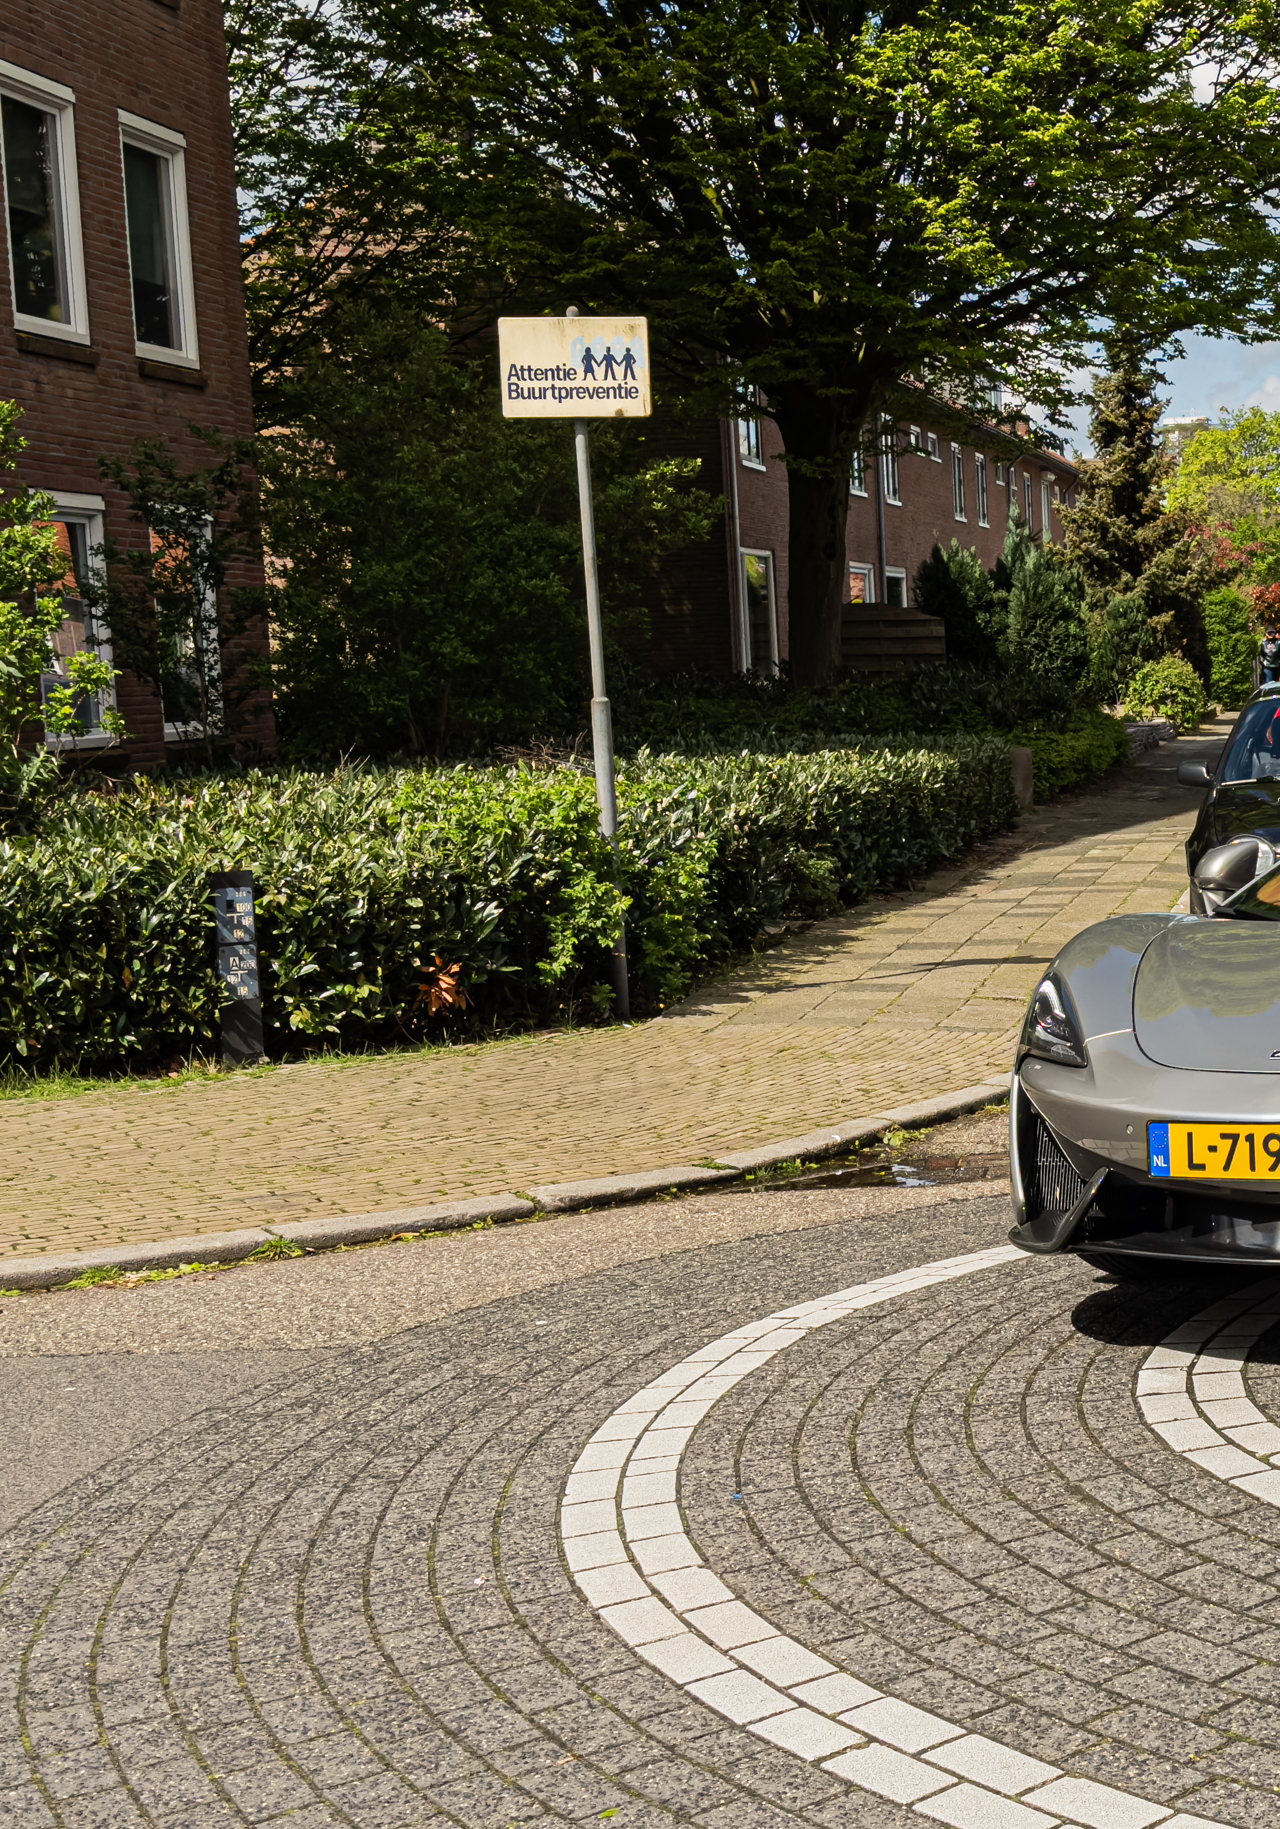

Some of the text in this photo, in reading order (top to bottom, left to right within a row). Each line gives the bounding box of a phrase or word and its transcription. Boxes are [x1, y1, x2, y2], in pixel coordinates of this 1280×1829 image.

[507, 363, 577, 381] Attentie
[507, 382, 639, 403] Buurtpreventie
[230, 957, 239, 969] A
[1153, 1154, 1168, 1167] NL
